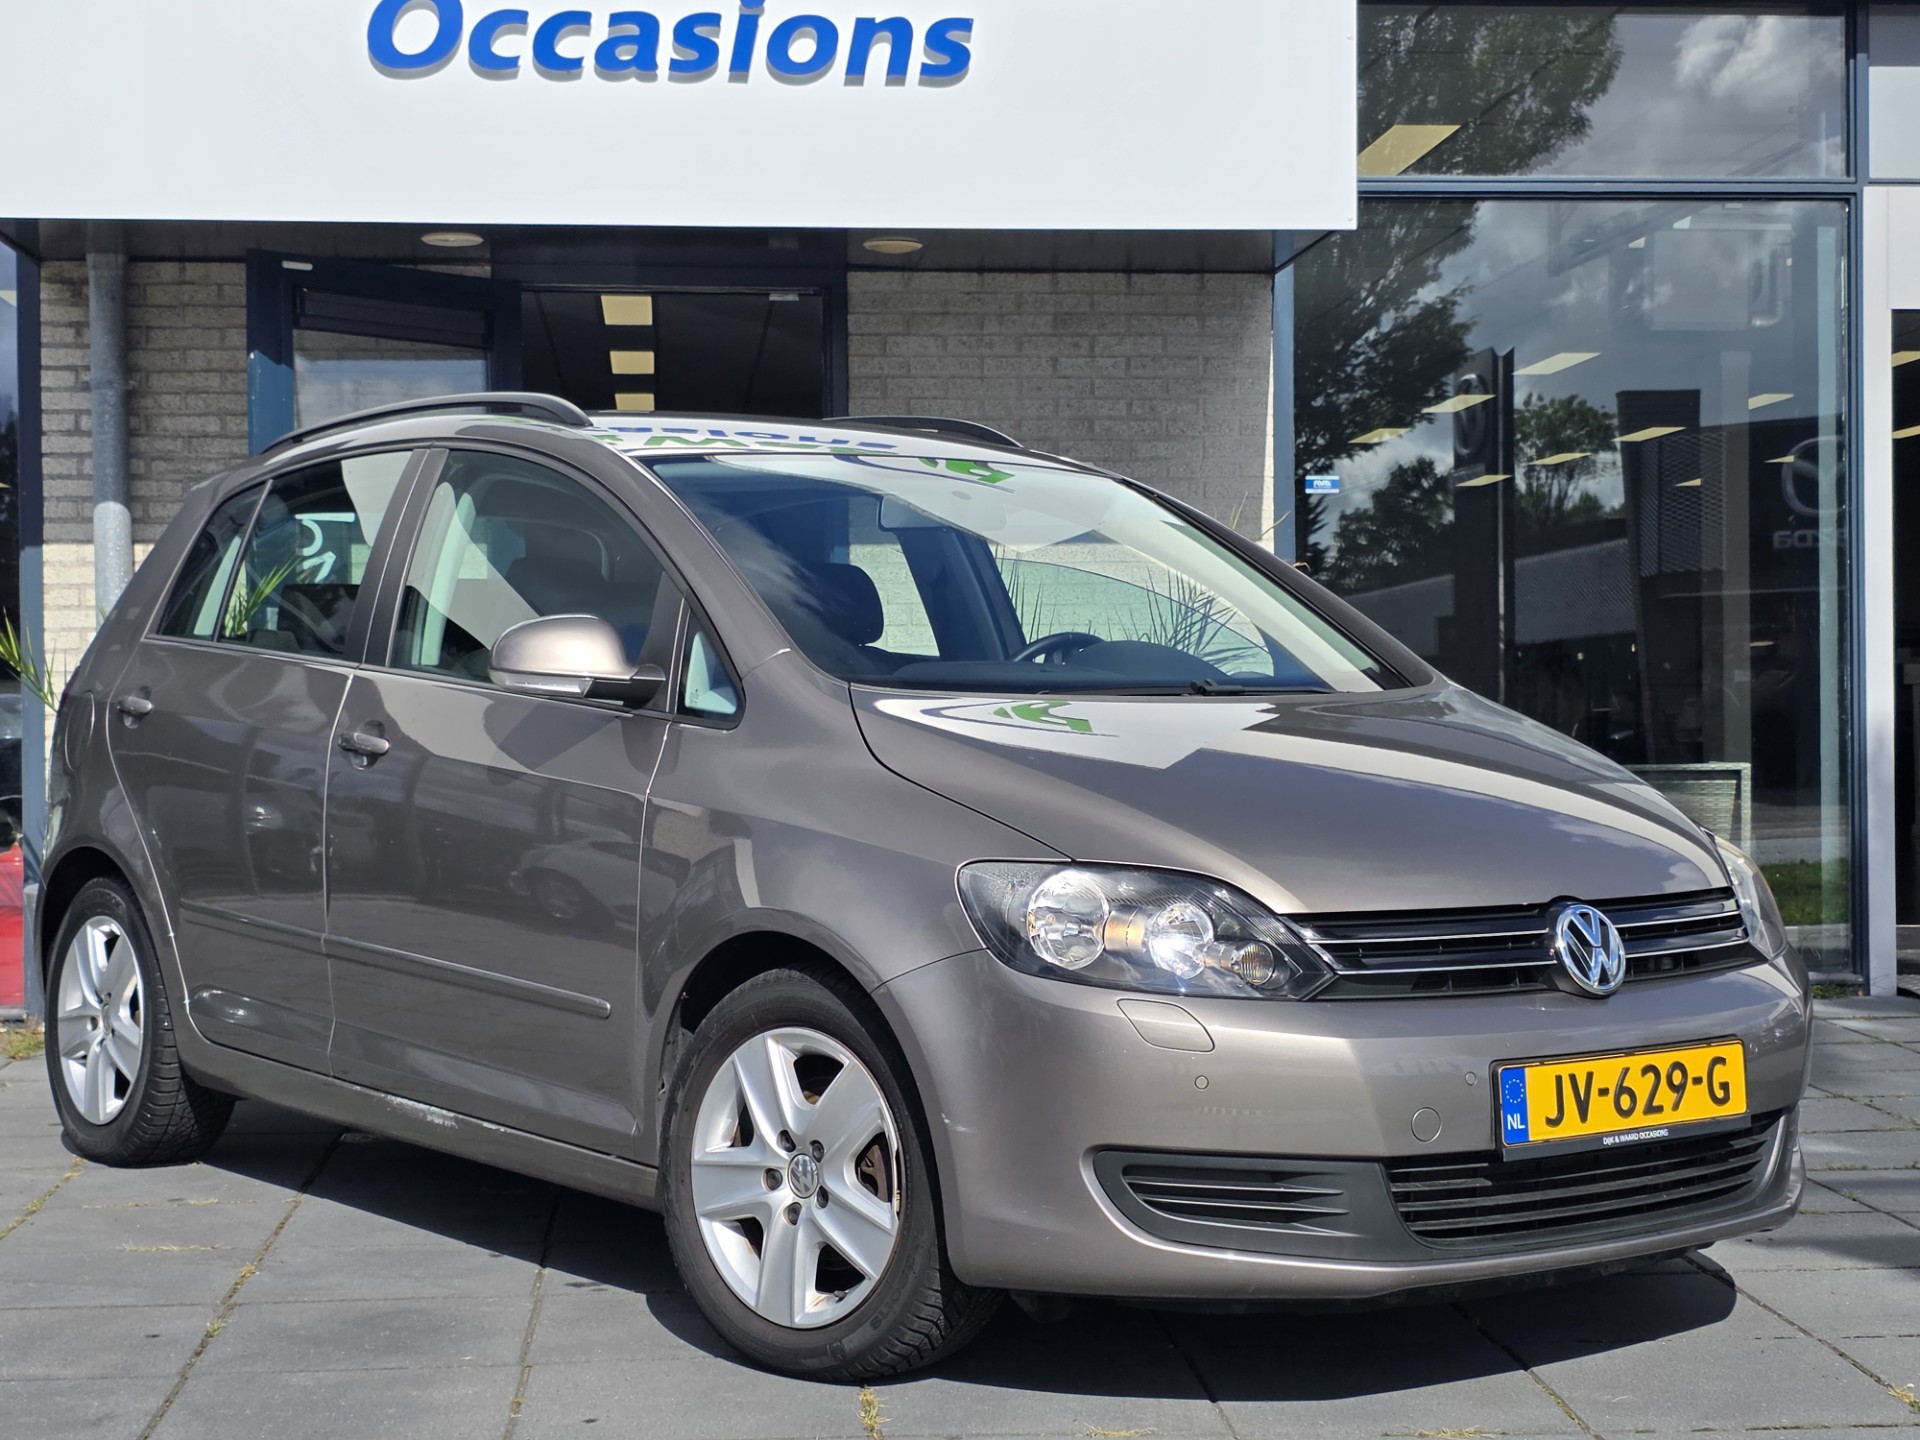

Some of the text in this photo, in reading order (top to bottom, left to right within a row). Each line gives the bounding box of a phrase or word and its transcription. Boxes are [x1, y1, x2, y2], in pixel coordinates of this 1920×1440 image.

[366, 0, 974, 83] Occasions
[1507, 1112, 1526, 1131] NL
[1544, 1055, 1731, 1129] JV-629-G
